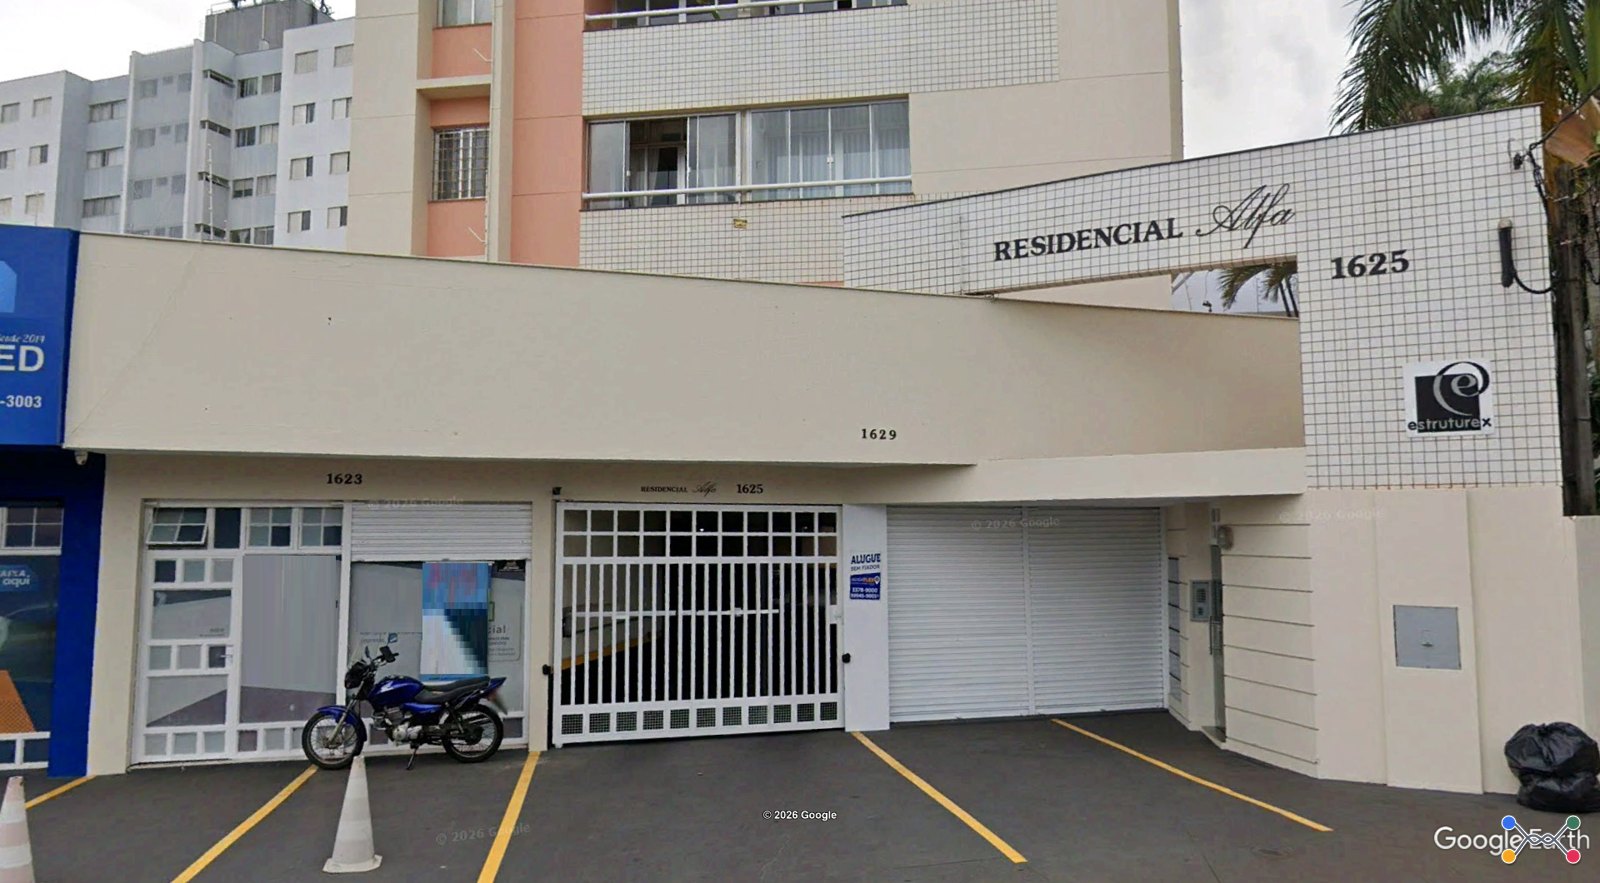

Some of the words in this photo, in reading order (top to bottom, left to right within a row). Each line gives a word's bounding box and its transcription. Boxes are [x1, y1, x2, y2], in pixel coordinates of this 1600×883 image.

[993, 217, 1184, 262] RESIDENCIAL
[1195, 183, 1297, 249] Alfa
[1331, 250, 1411, 279] 1625
[1407, 417, 1492, 431] estruturex
[861, 428, 897, 440] 1629
[326, 473, 363, 485] 1623
[640, 485, 688, 493] RESIDENCIAL
[692, 480, 718, 497] Alfa
[736, 483, 764, 494] 1625
[850, 553, 881, 564] ALUGUE
[2, 575, 30, 588] aqui
